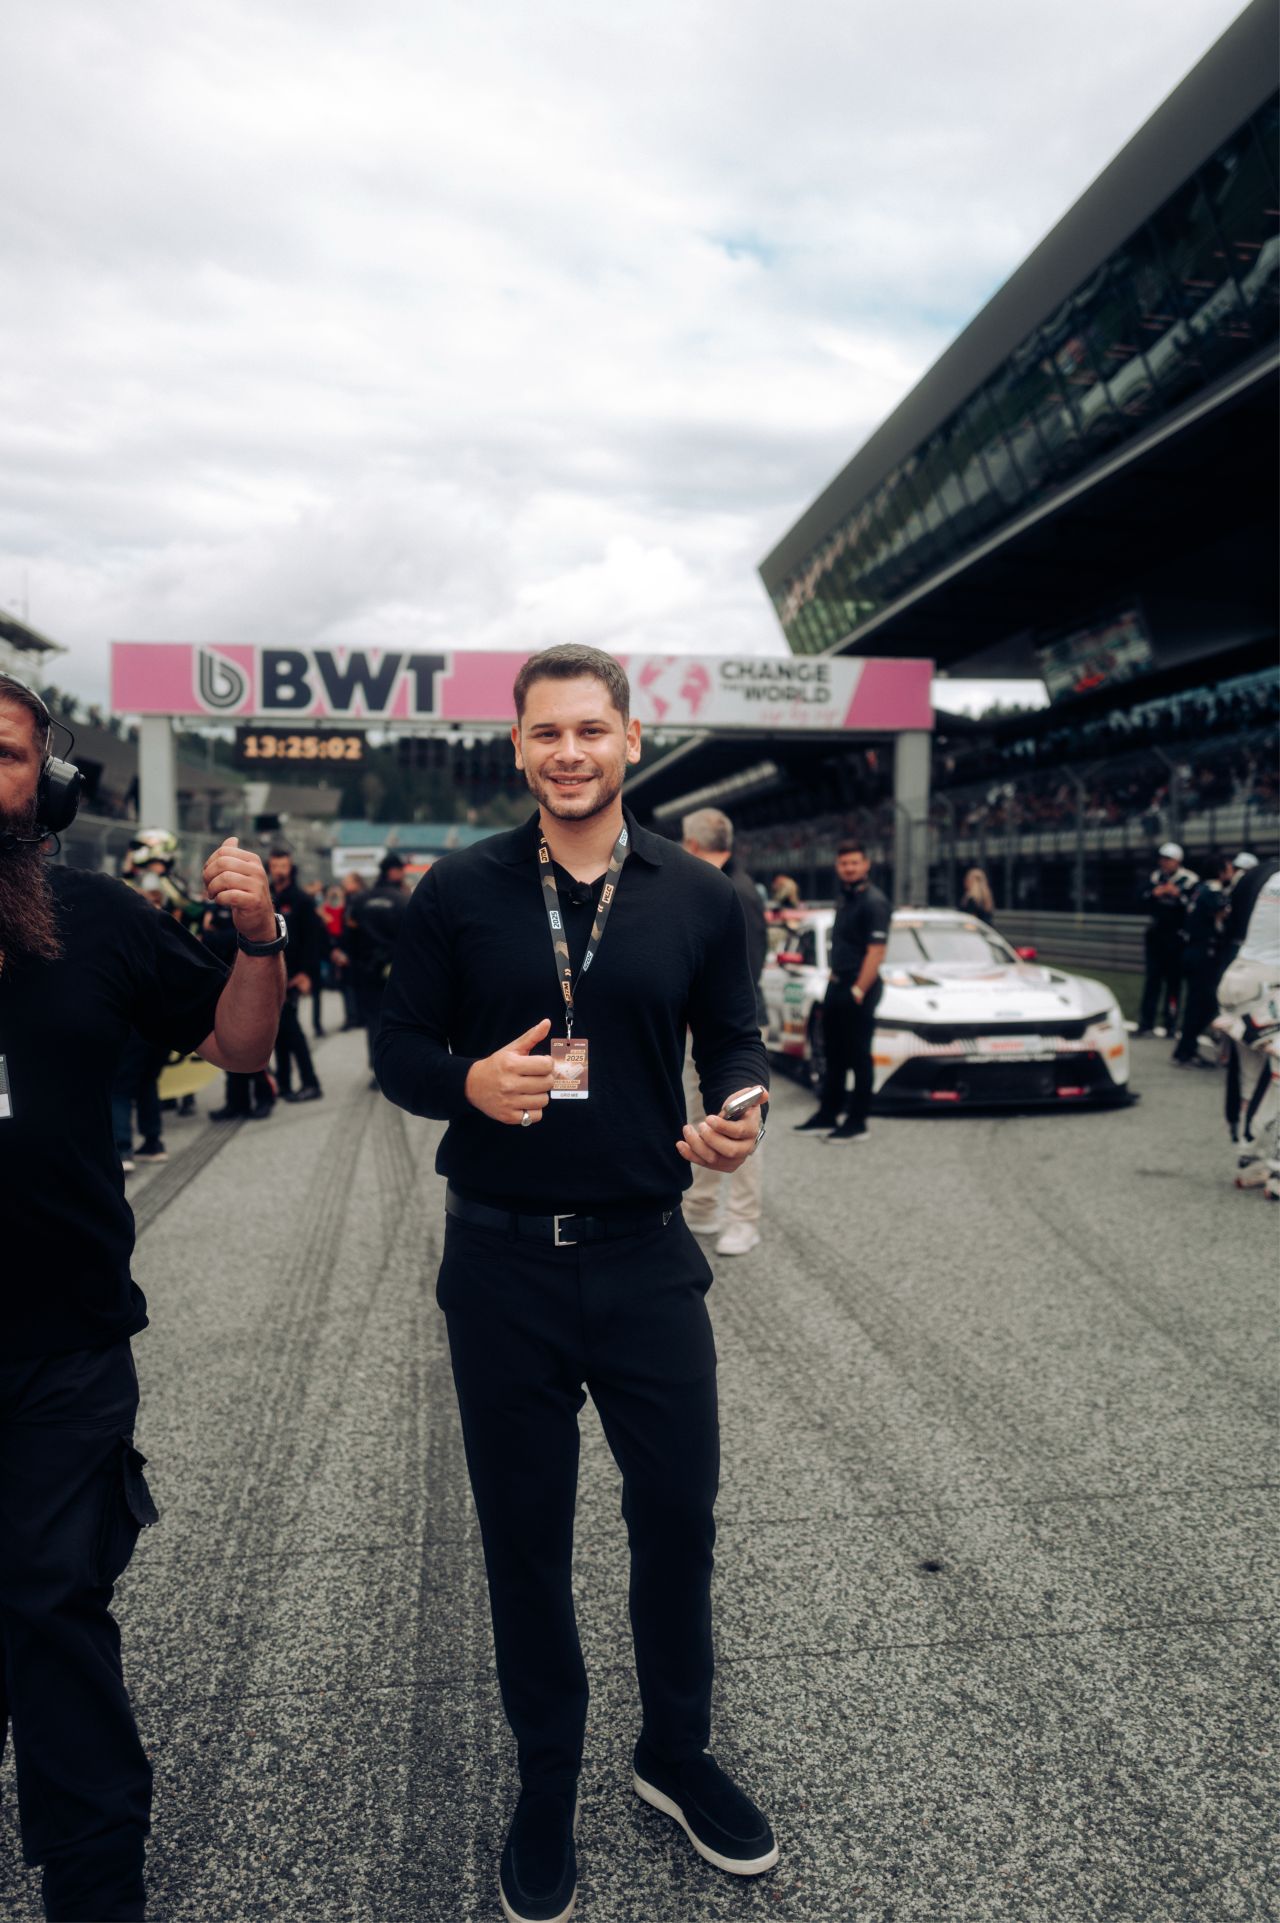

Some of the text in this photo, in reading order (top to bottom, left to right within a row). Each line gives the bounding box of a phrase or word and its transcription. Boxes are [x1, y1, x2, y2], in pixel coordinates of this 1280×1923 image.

[262, 650, 445, 713] BWT
[720, 660, 831, 683] CHANGE
[744, 686, 831, 703] WORLD
[244, 735, 362, 760] 13:25:02
[550, 911, 560, 928] 2025
